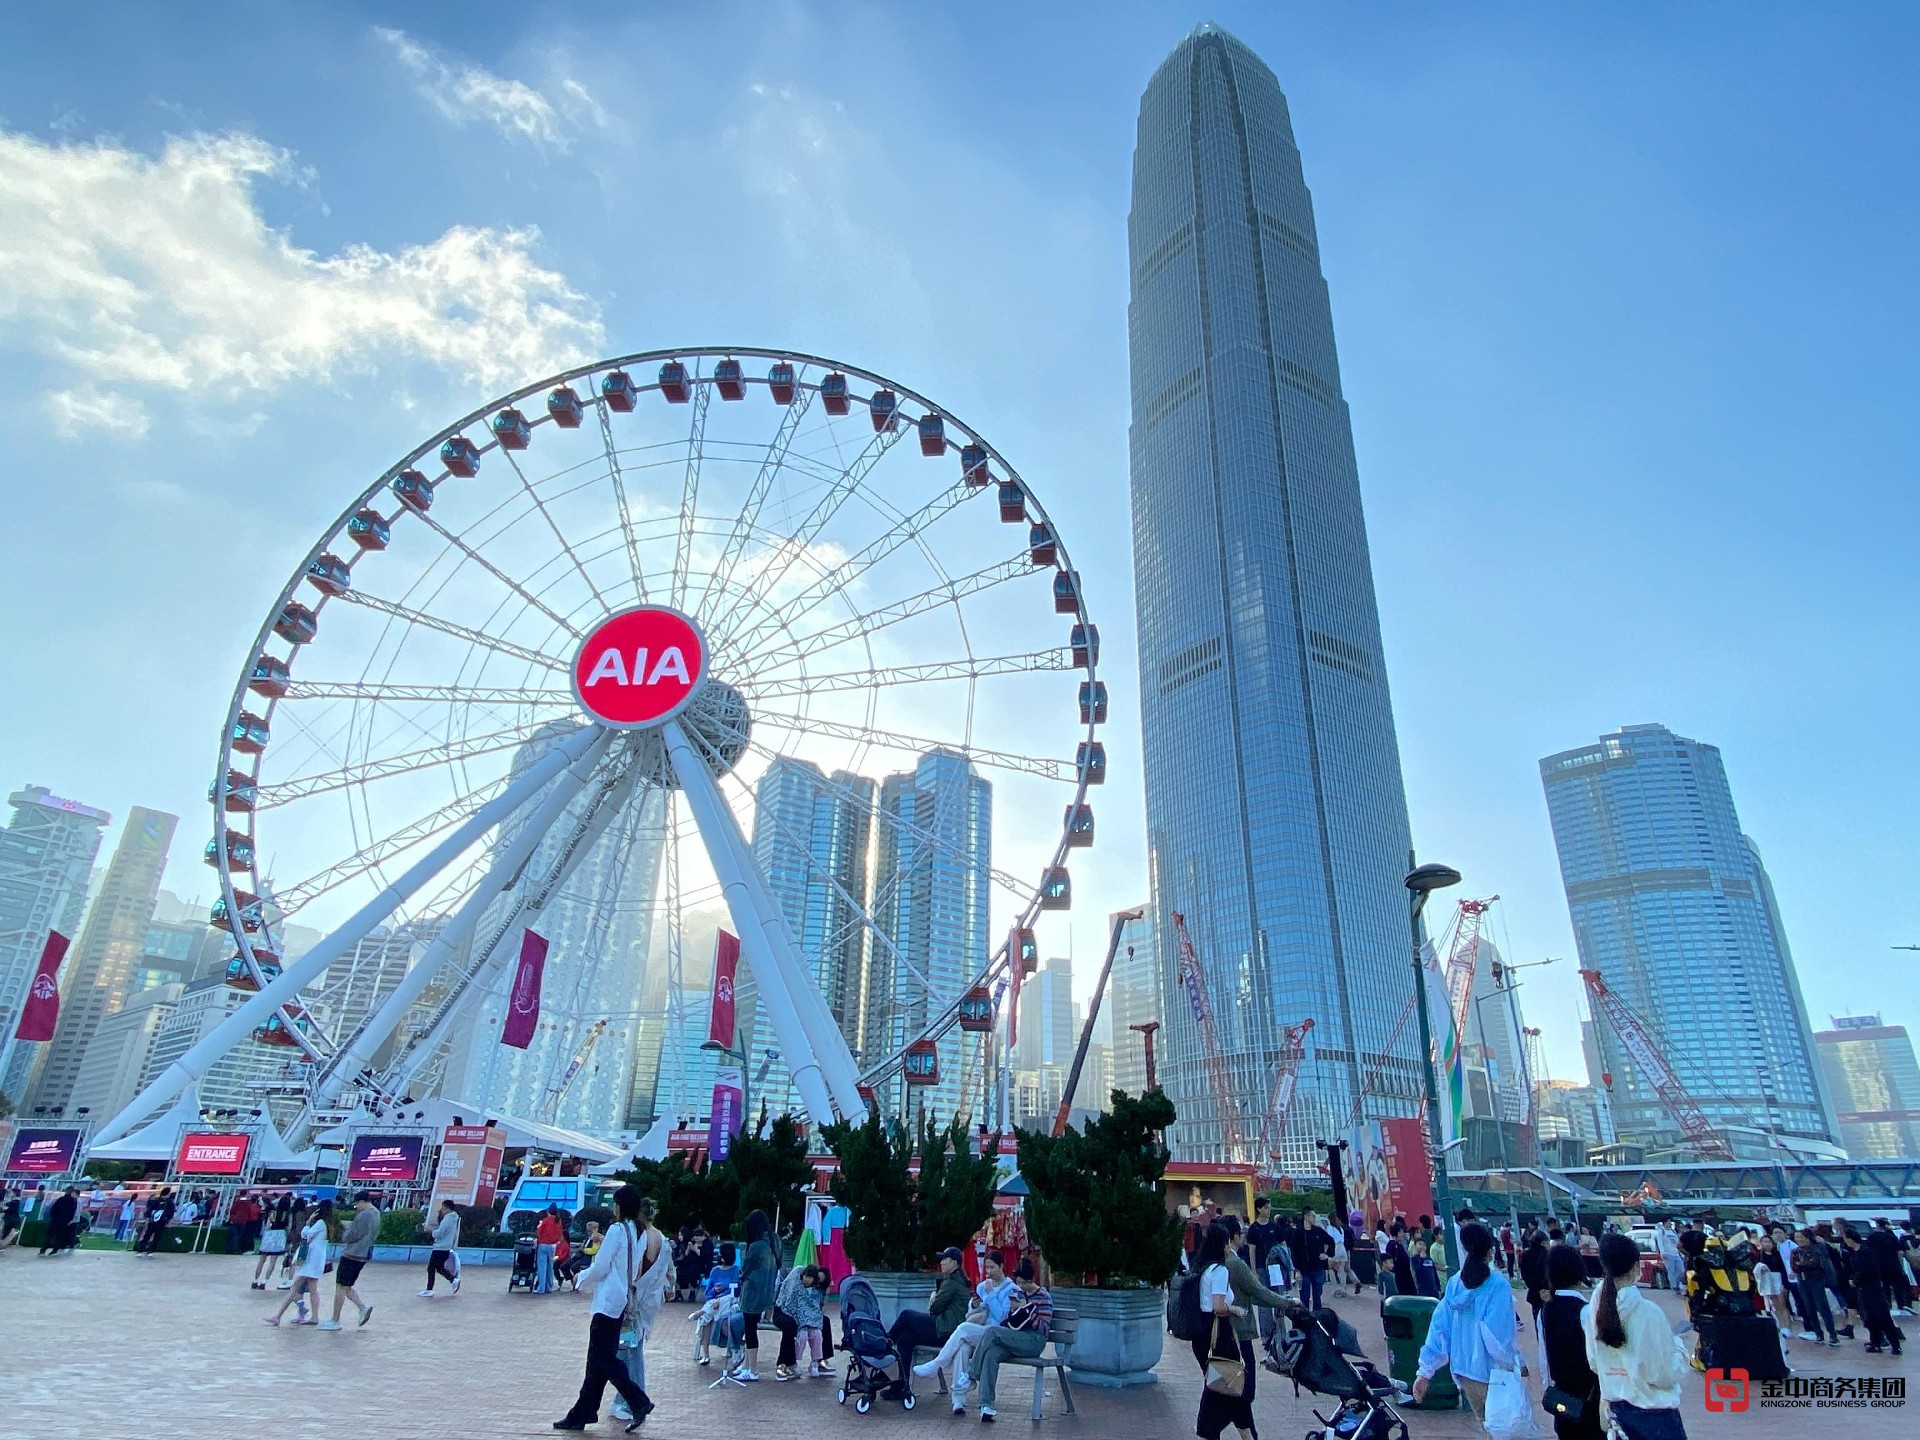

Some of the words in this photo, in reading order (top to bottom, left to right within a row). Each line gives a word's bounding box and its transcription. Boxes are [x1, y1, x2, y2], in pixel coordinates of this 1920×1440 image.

[585, 646, 691, 687] AIA
[187, 1149, 238, 1159] ENTRANCE
[444, 1151, 459, 1159] ONE
[442, 1160, 464, 1168] CLEAR
[440, 1169, 458, 1177] GOAL
